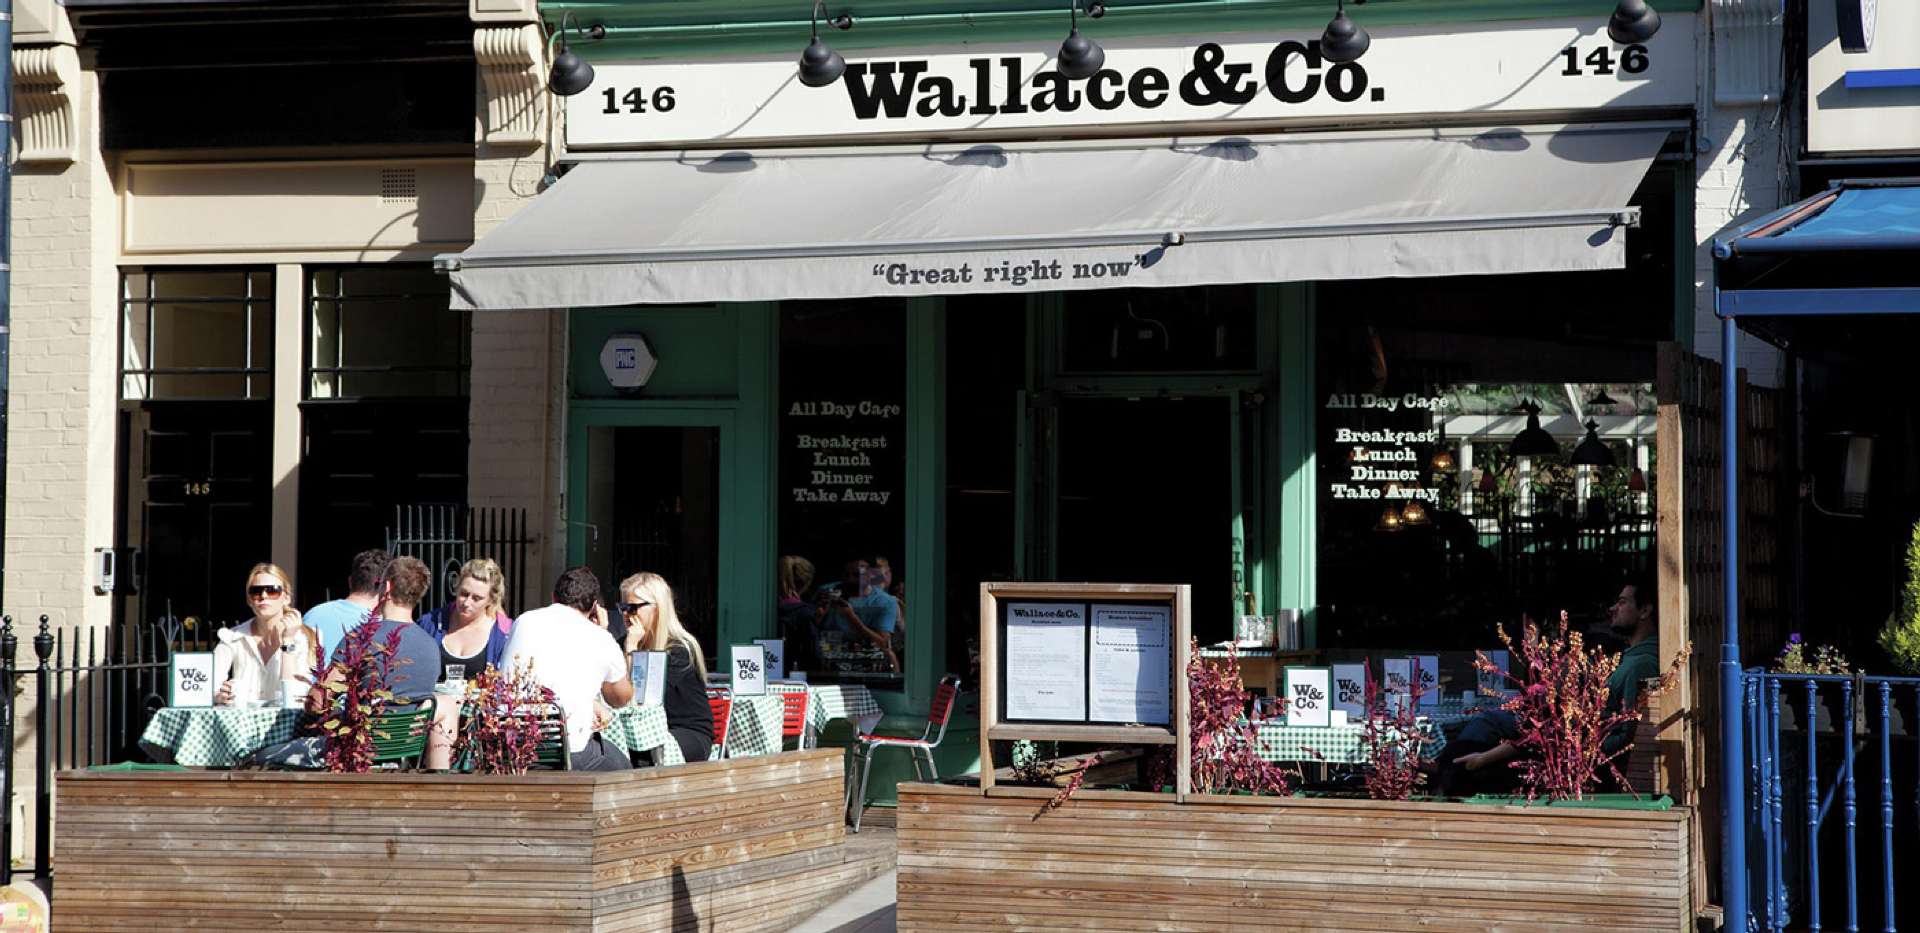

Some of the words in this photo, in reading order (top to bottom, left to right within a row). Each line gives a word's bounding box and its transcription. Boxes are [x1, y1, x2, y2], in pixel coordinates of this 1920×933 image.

[1561, 44, 1650, 76] 146
[602, 86, 676, 114] 146
[983, 259, 1062, 286] right
[788, 401, 817, 416] All
[819, 400, 857, 419] Day
[858, 400, 901, 419] Cafe
[1325, 393, 1358, 409] All
[1360, 393, 1401, 412] Day
[1402, 393, 1449, 411] Cafe
[796, 434, 888, 451] Breakfast
[1335, 428, 1436, 446] Breakfast
[813, 451, 871, 467] Lunch
[1352, 446, 1417, 462] Lunch
[810, 470, 874, 485] Dinner
[1350, 465, 1419, 481] Dinner
[792, 488, 838, 502] Take
[840, 488, 891, 505] Away
[1330, 483, 1380, 499] Take
[1384, 484, 1440, 503] Away
[736, 659, 761, 672] W&
[178, 667, 209, 682] W&
[180, 680, 203, 692] Co.
[1292, 683, 1325, 700] W&
[1336, 679, 1362, 694] W&
[1294, 697, 1319, 710] Co.
